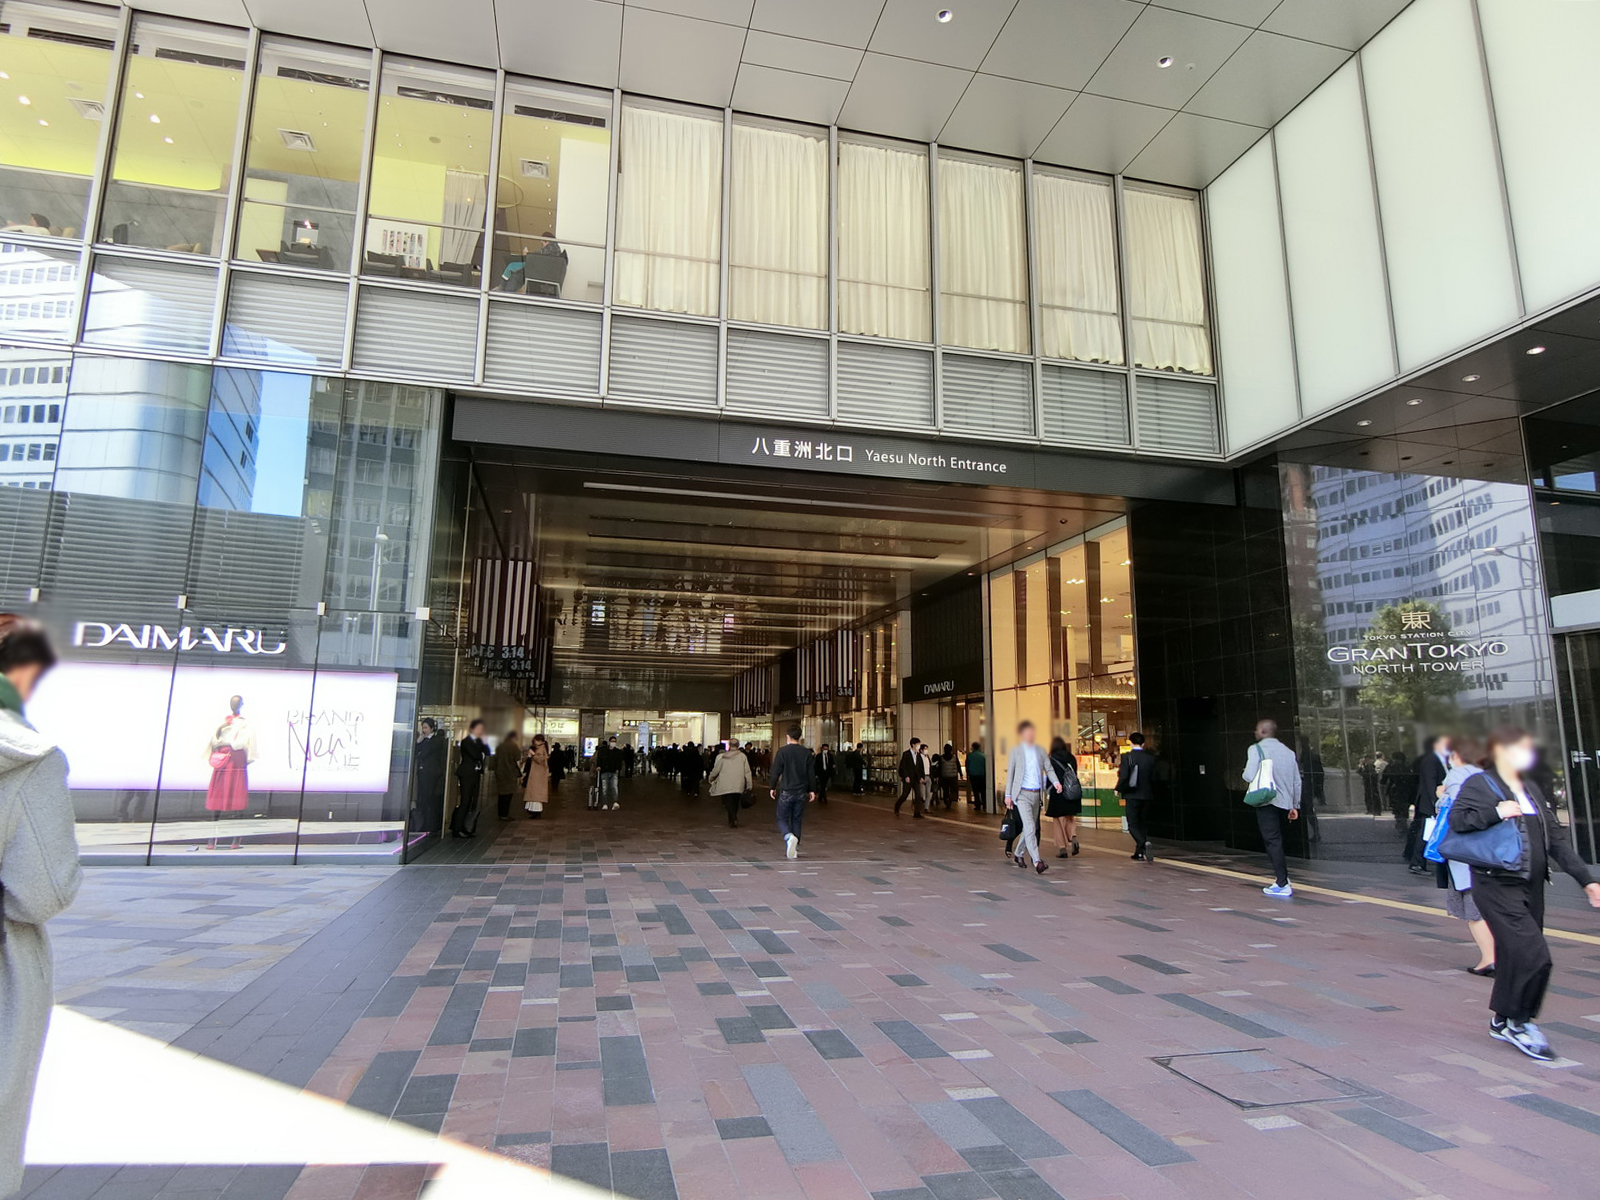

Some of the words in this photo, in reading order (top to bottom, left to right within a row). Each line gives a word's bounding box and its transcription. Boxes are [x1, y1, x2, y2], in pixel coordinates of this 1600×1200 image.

[752, 437, 853, 462] 八重洲北口
[865, 449, 904, 464] Yaesu
[908, 453, 946, 467] North
[950, 457, 1007, 473] Entrance
[74, 621, 286, 654] DAIMARU
[501, 646, 525, 659] 3.14
[510, 660, 532, 671] 3.14
[1352, 664, 1413, 675] NORTH
[1419, 661, 1483, 672] TOWER
[815, 691, 830, 701] 3.14
[838, 687, 853, 696] 3.14
